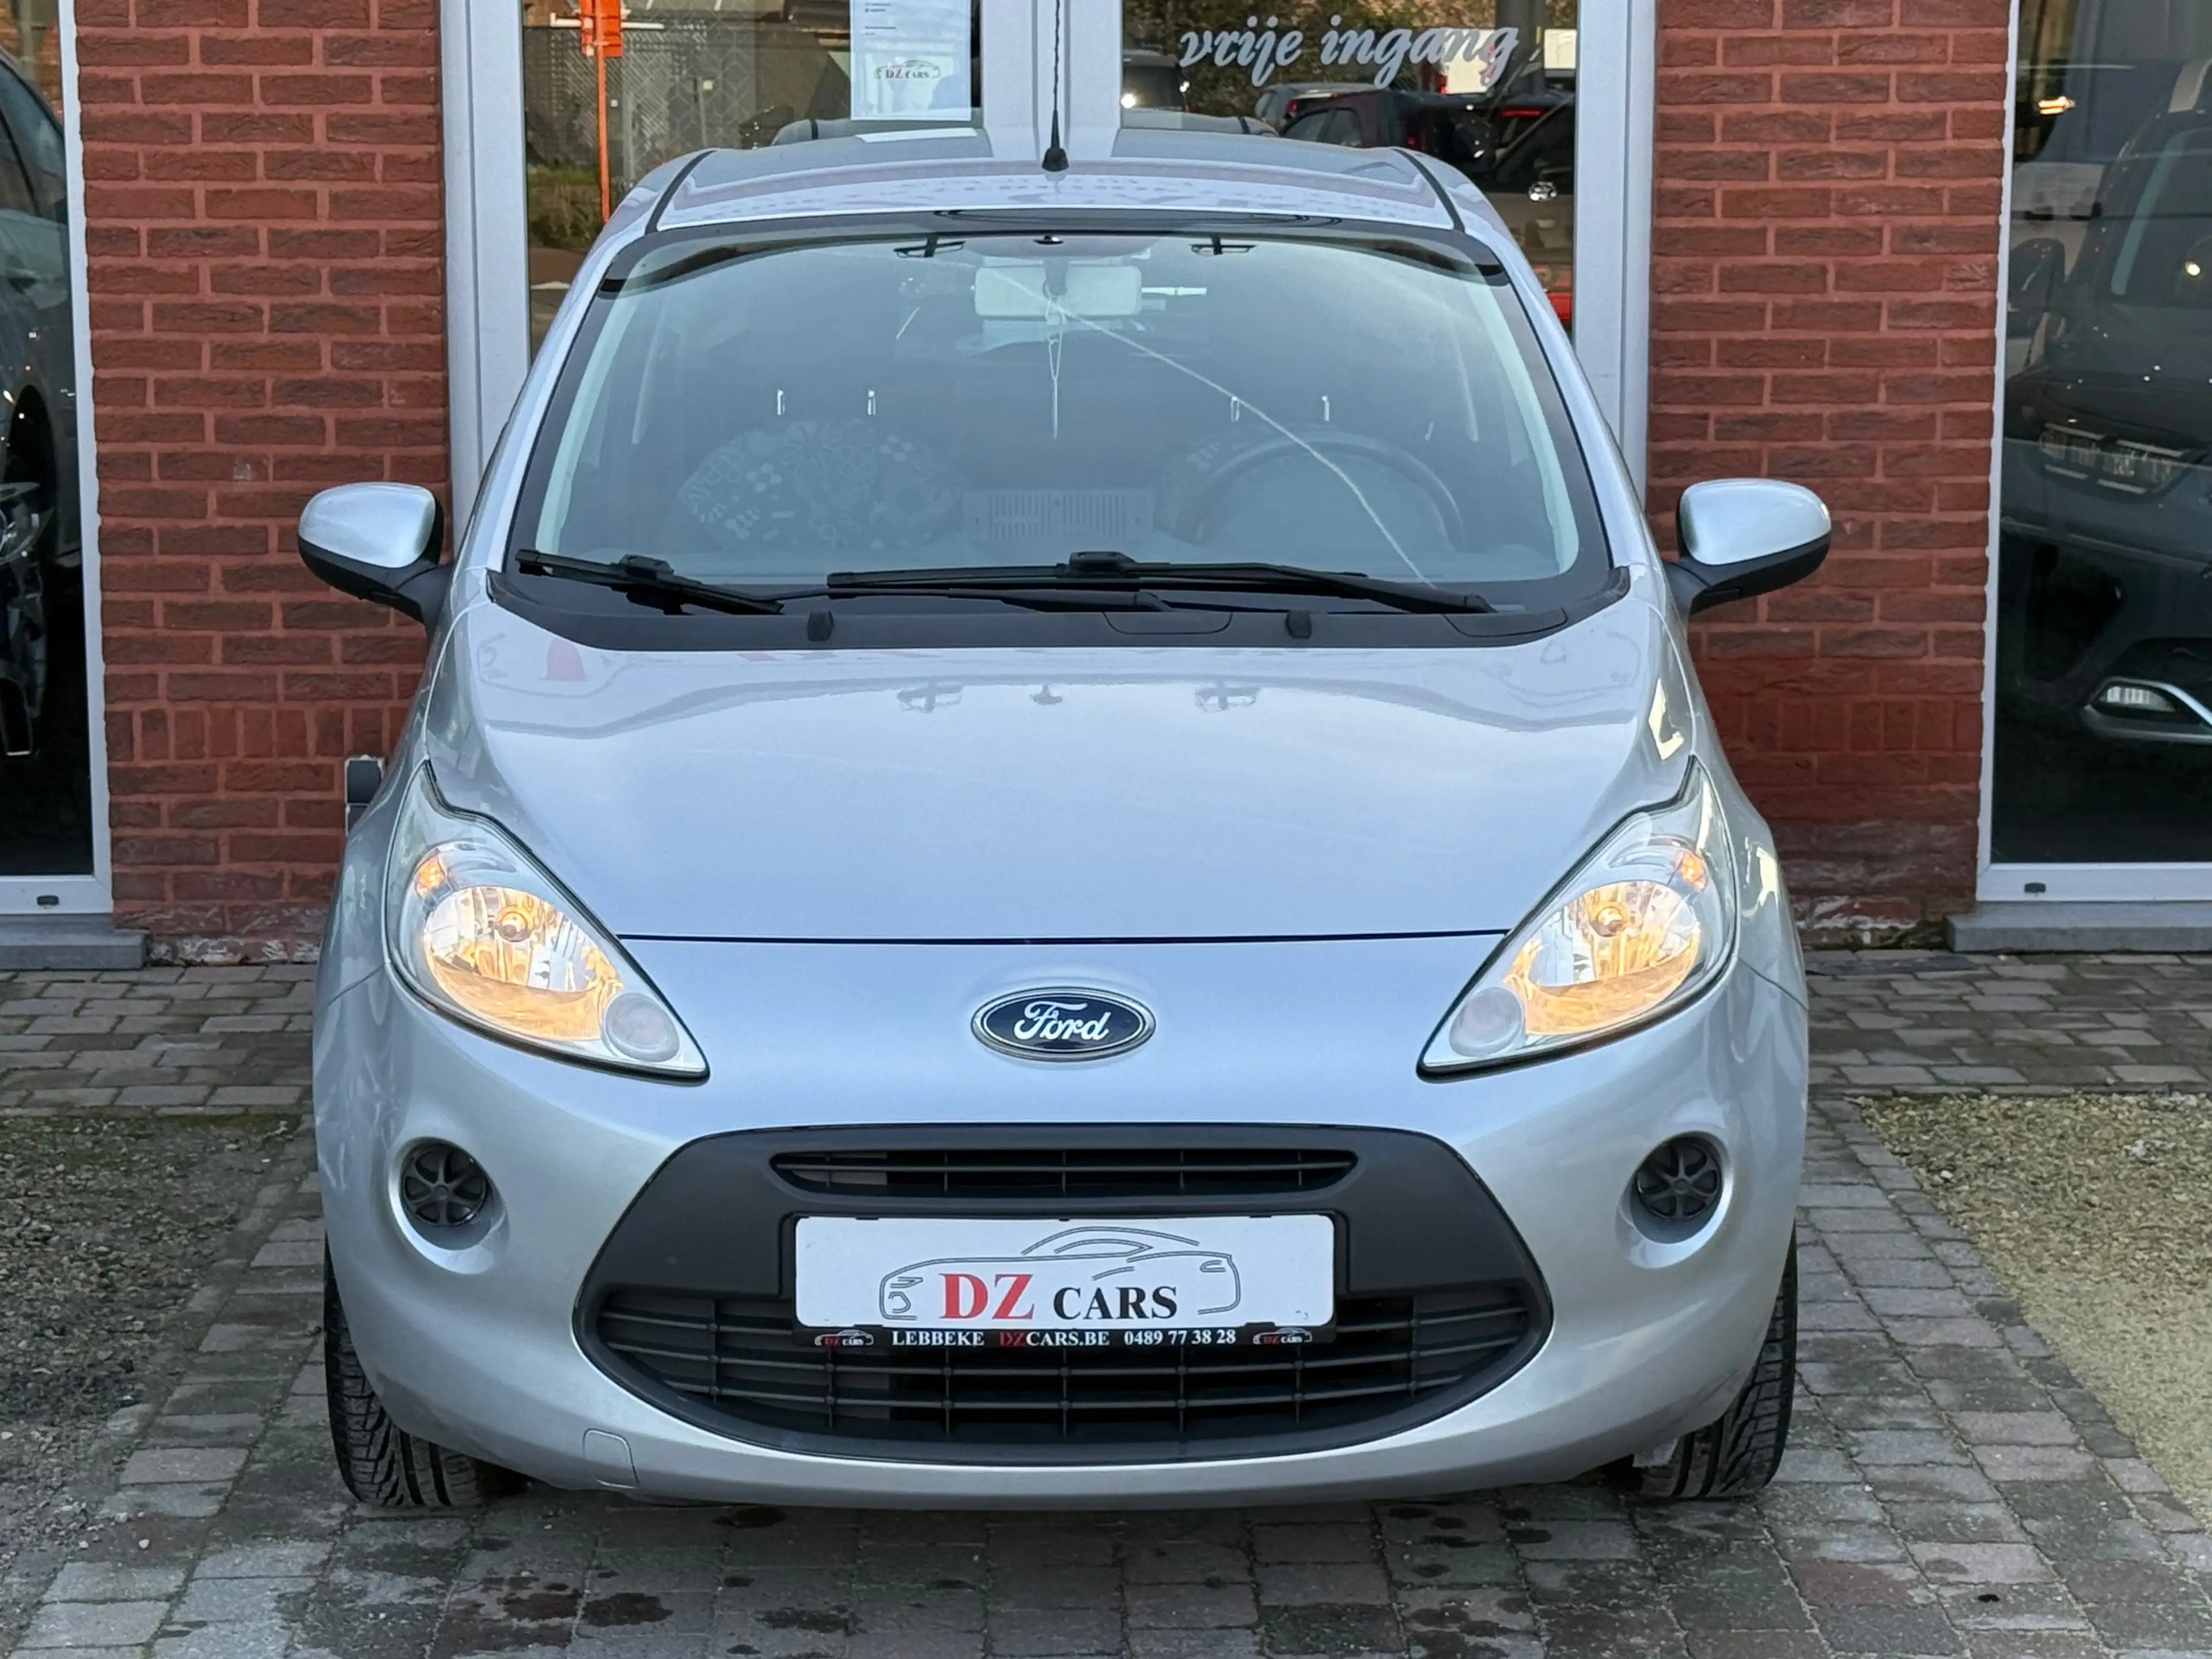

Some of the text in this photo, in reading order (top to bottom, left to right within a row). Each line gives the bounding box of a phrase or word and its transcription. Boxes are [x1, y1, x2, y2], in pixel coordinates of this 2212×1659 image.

[1179, 14, 1519, 90] vrije ingang
[1013, 1000, 1112, 1040] Ford
[939, 1272, 1178, 1321] DZ CARS
[892, 1329, 1236, 1347] LEBBEKE DZCARS.BE 0489 77 38 28
